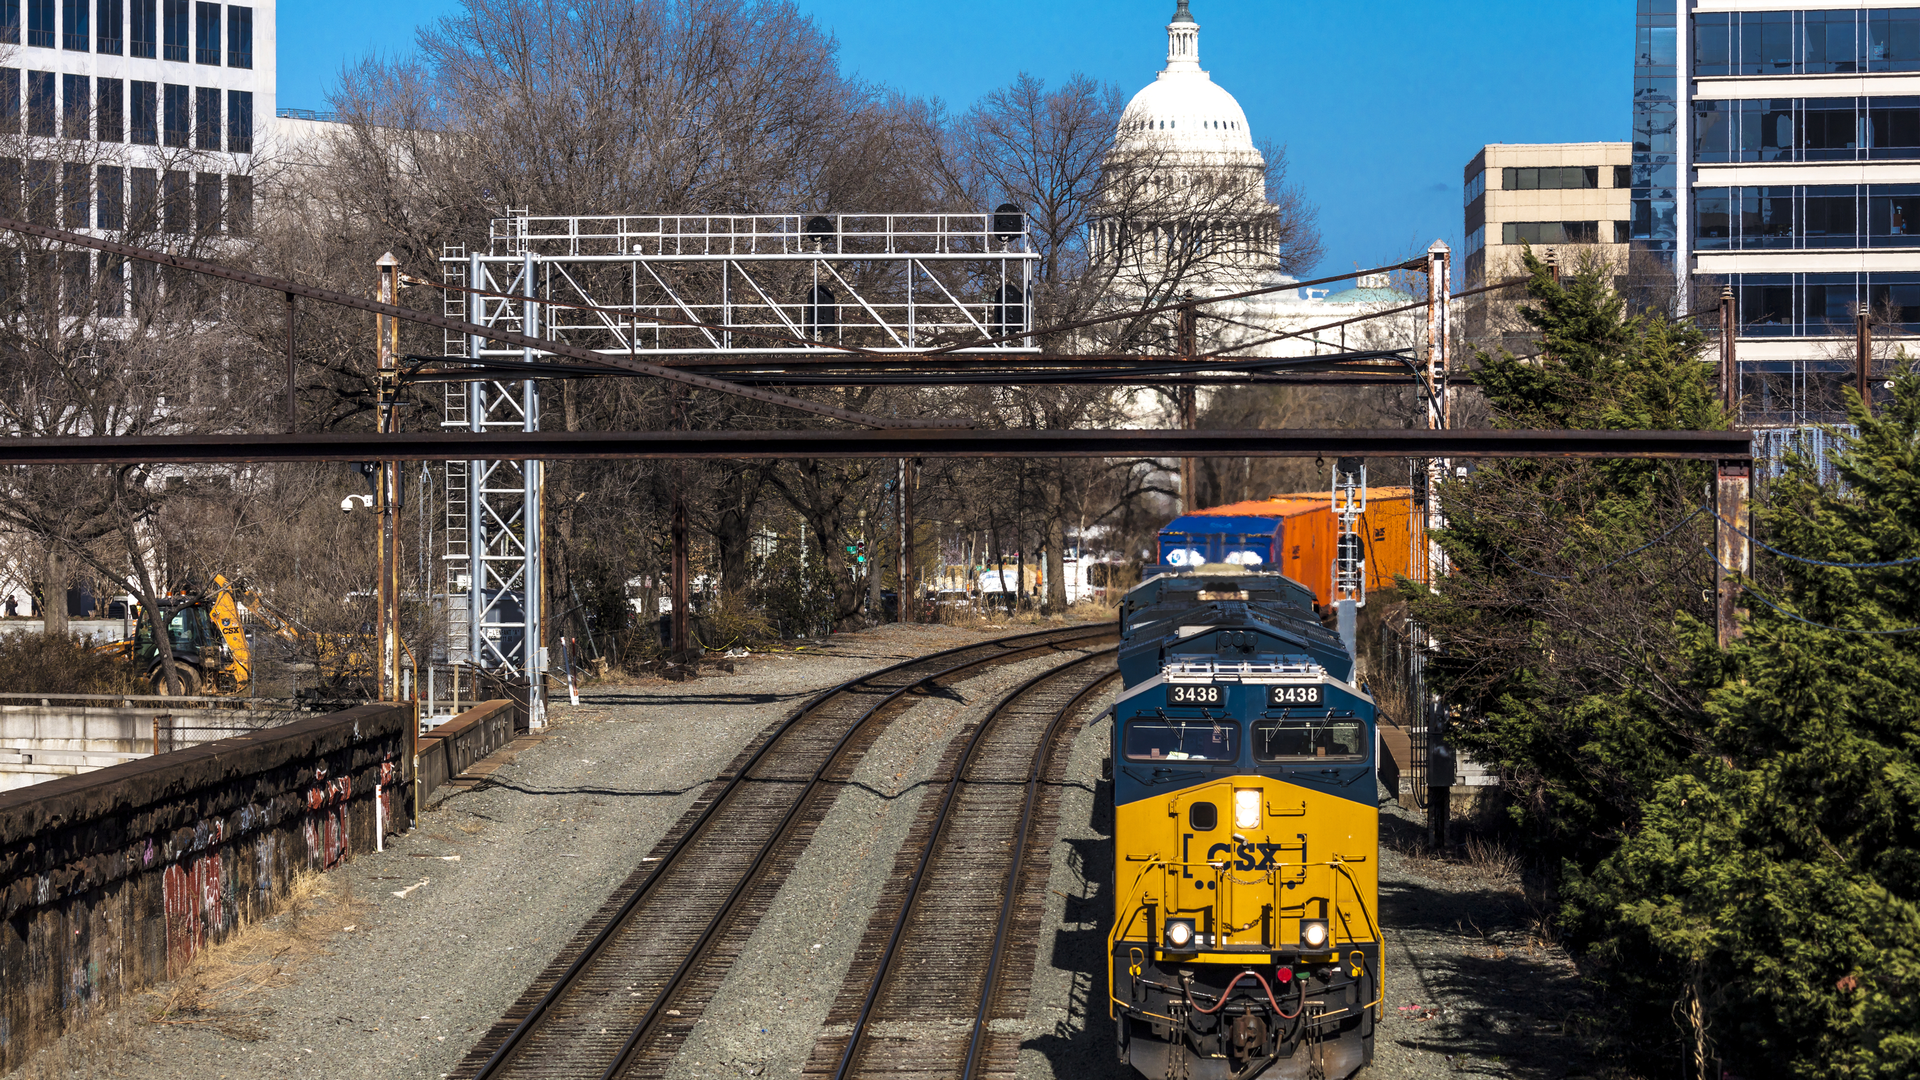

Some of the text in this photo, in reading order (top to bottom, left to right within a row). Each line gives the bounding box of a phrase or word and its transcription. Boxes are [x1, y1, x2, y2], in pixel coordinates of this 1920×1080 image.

[1174, 687, 1218, 702] 3438
[1274, 687, 1318, 702] 3438
[1207, 843, 1281, 872] CSX
